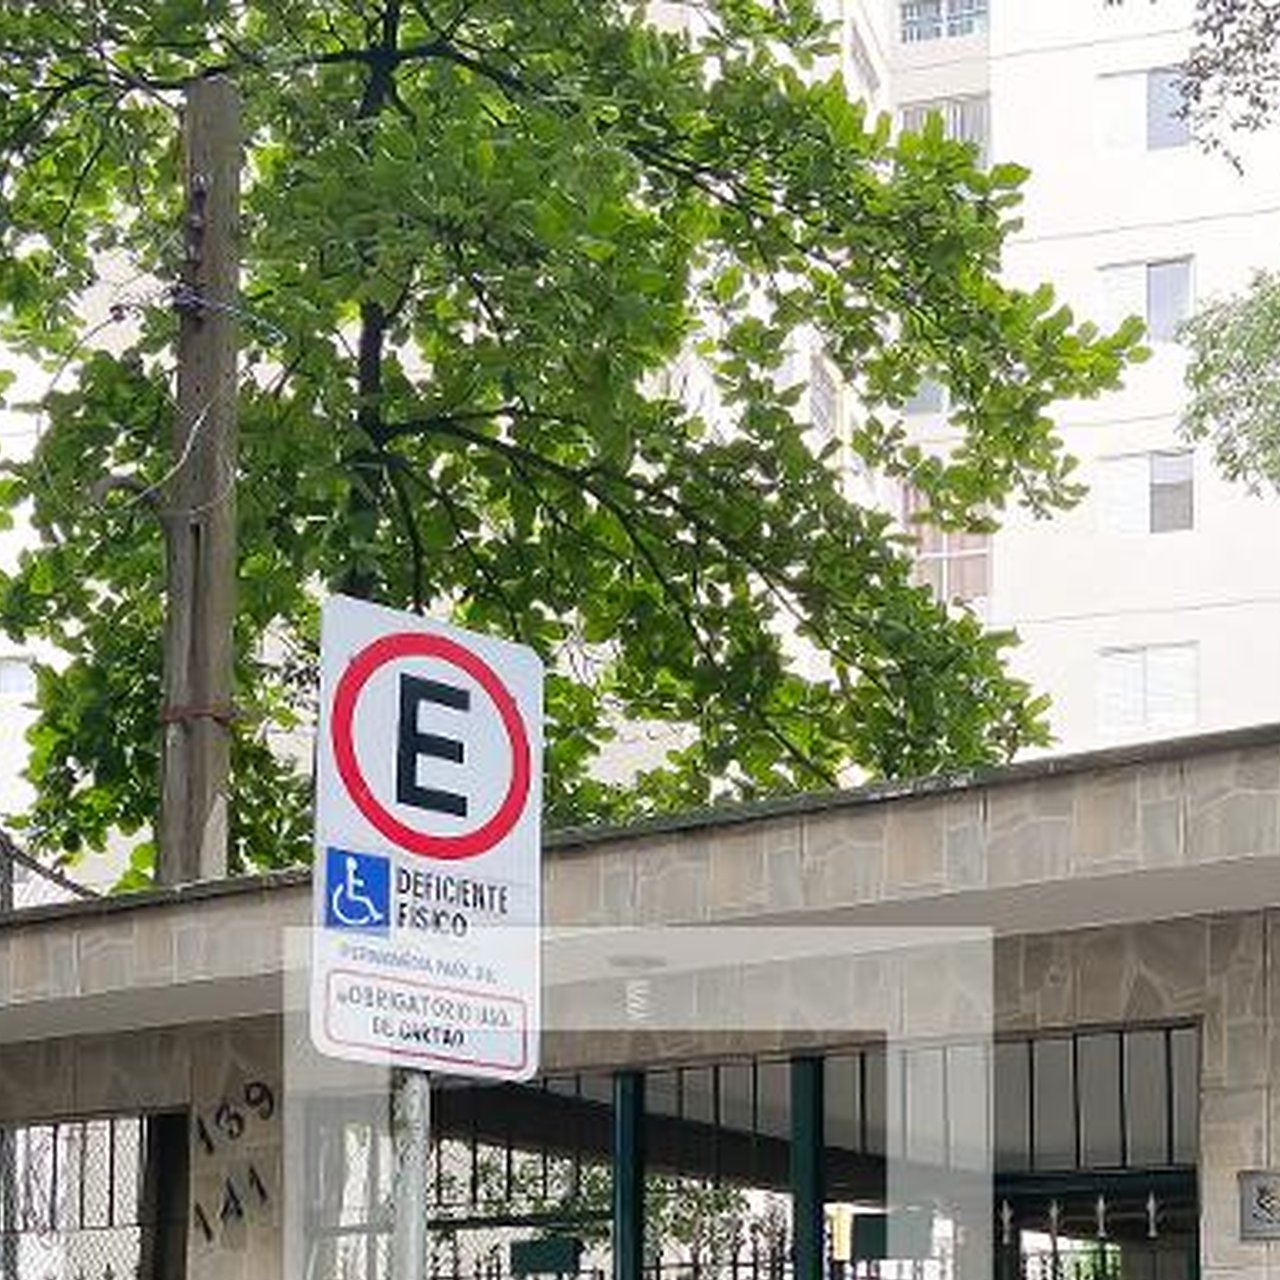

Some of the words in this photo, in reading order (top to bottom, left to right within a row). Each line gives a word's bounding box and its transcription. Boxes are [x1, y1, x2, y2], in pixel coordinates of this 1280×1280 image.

[396, 672, 471, 818] E
[397, 866, 508, 914] DEFICIENTE
[196, 1081, 275, 1156] 139
